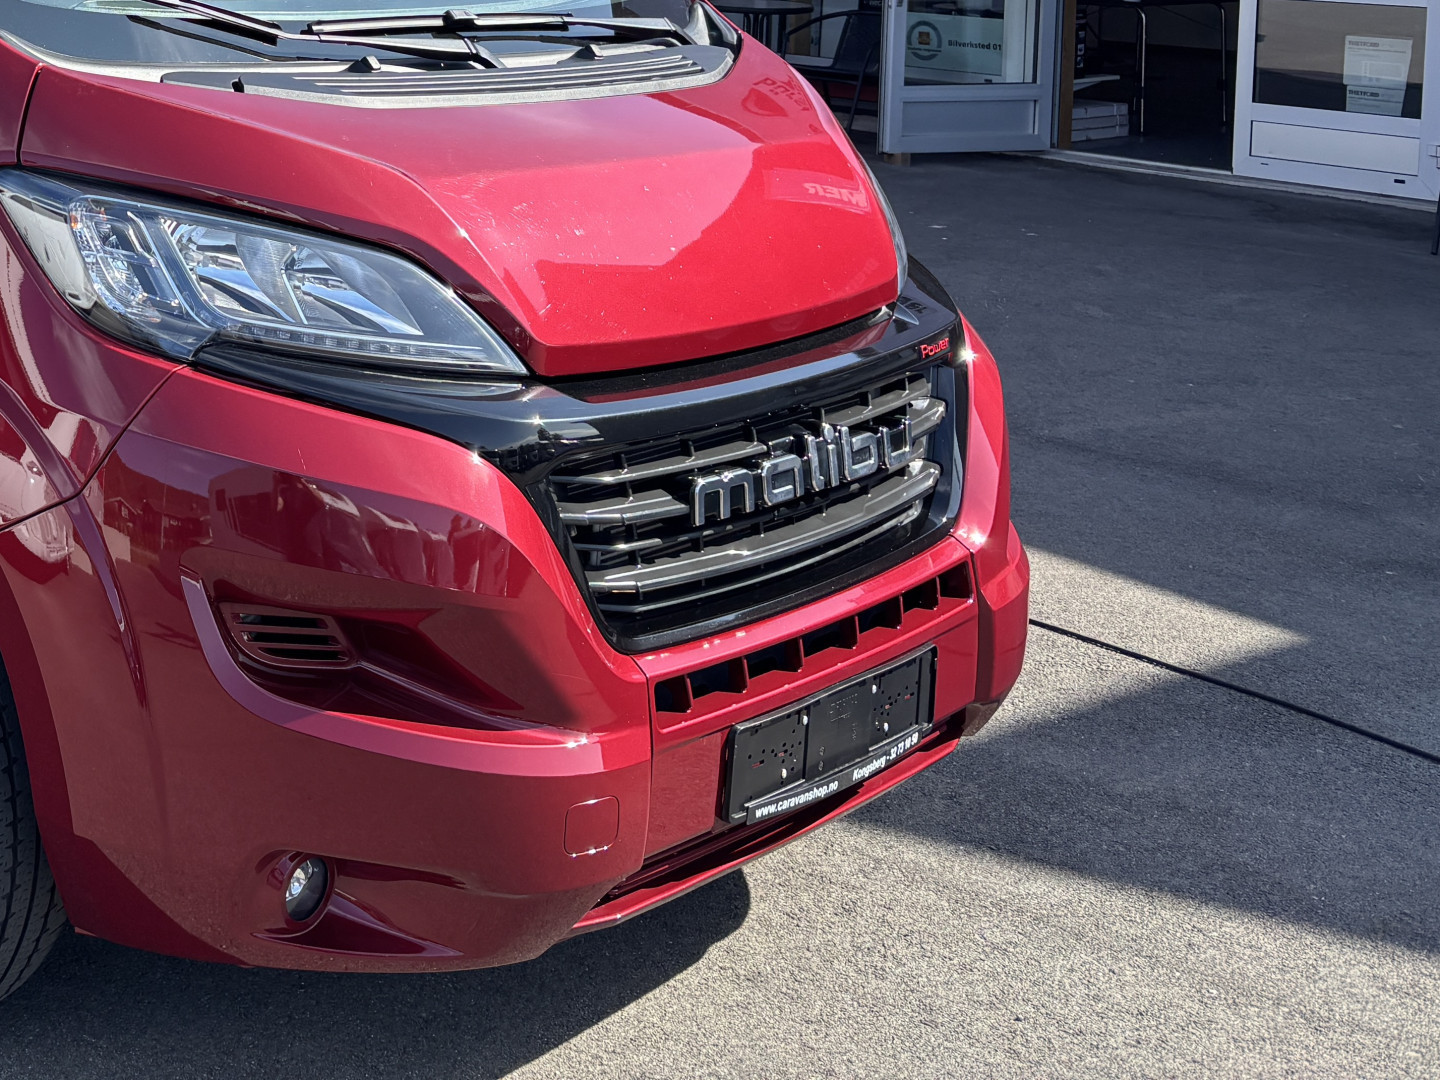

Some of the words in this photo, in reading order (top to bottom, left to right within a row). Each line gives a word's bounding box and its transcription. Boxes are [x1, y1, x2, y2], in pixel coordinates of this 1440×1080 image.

[947, 39, 991, 50] Bilverksted
[920, 337, 950, 359] Power
[691, 417, 913, 527] malibu
[755, 780, 839, 819] www.caravanshop.no
[852, 755, 887, 782] Kongsberg
